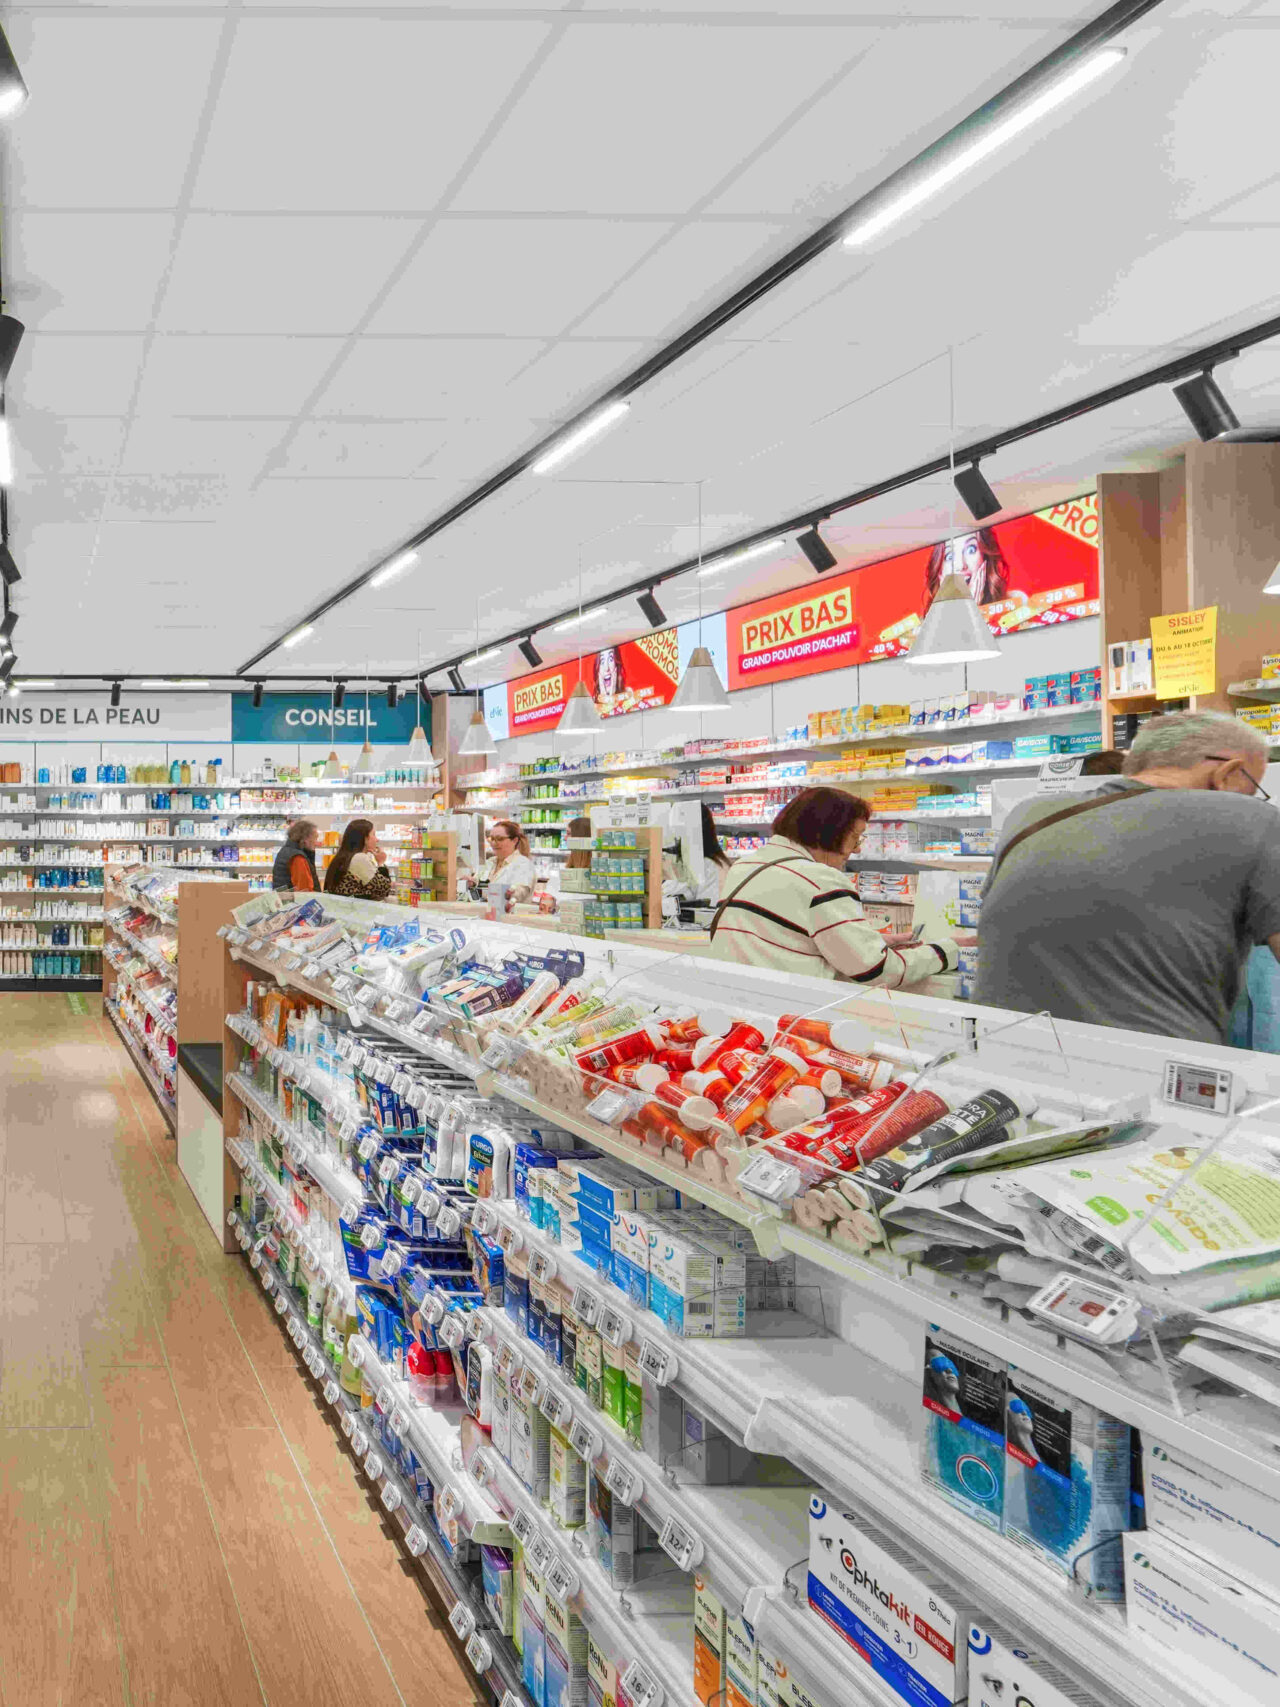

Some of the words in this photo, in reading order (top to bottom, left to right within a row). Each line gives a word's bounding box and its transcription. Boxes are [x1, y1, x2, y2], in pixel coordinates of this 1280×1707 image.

[1050, 500, 1100, 539] PRO
[745, 615, 795, 651] PRIX
[800, 594, 848, 631] BAS
[1168, 613, 1206, 628] SISLEY
[1172, 626, 1204, 636] ANIMATION
[640, 637, 680, 681] PROMOS
[742, 654, 770, 670] GRAND
[772, 643, 811, 662] POUVOIR
[812, 634, 851, 653] D'ACHAT
[516, 687, 538, 707] PRIX
[540, 678, 562, 700] BAS
[39, 707, 67, 725] DE
[73, 707, 99, 725] LA
[105, 707, 161, 725] PEAU
[285, 708, 377, 727] CONSEIL
[1070, 735, 1102, 744] GAVISCON
[475, 1141, 493, 1154] URGO
[962, 1350, 990, 1368] OCULAIRE
[930, 1402, 950, 1417] CHAUD
[1151, 1473, 1188, 1496] COVID-19
[839, 1546, 912, 1627] Ophtakit
[545, 1594, 564, 1629] ReNu
[830, 1572, 838, 1585] KIT
[839, 1580, 845, 1592] DE
[846, 1587, 872, 1617] PREMIERS
[873, 1610, 889, 1633] SOINS
[936, 1609, 951, 1626] Théa
[727, 1626, 751, 1655] BLEPHA
[927, 1628, 950, 1656] ROUGE
[589, 1641, 608, 1680] ReNu
[792, 1683, 812, 1707] BLEP
